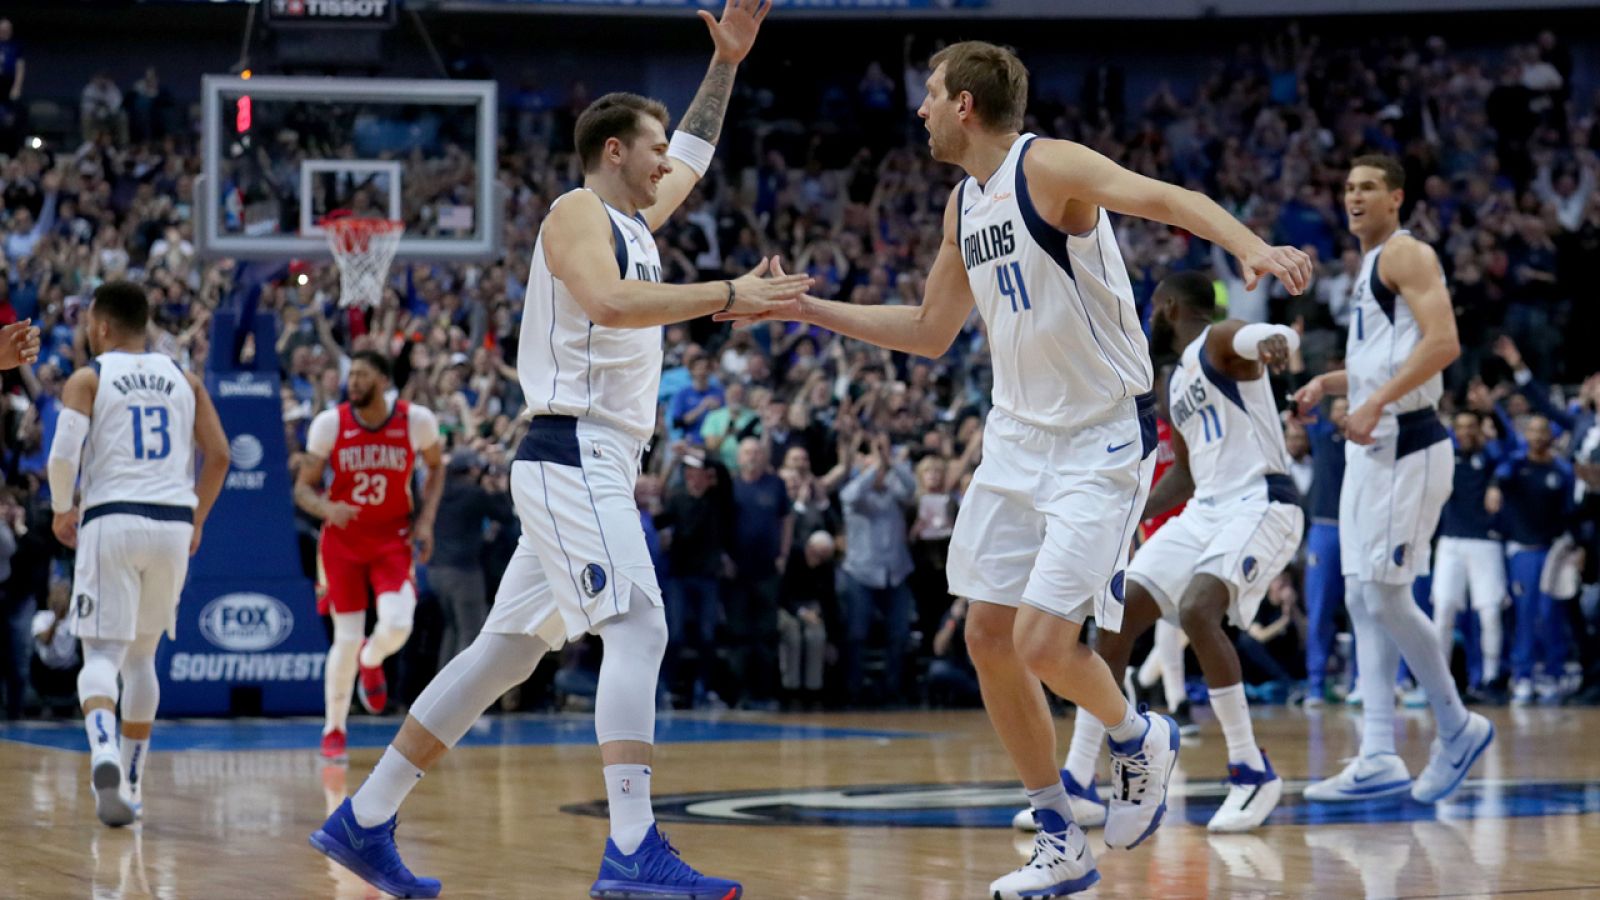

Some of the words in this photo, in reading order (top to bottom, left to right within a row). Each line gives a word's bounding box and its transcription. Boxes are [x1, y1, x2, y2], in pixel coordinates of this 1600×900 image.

[306, 0, 386, 17] TISSOT
[964, 220, 1016, 270] DALLAS
[996, 261, 1031, 313] 41
[112, 373, 175, 396] BRINSON
[1171, 377, 1206, 428] DALLAS
[127, 406, 171, 460] 13
[1198, 404, 1223, 442] 11
[338, 444, 407, 472] PELICANS
[225, 471, 267, 490] AT&T
[352, 471, 387, 506] 23
[221, 606, 270, 629] FOX
[170, 652, 326, 681] SOUTHWEST
